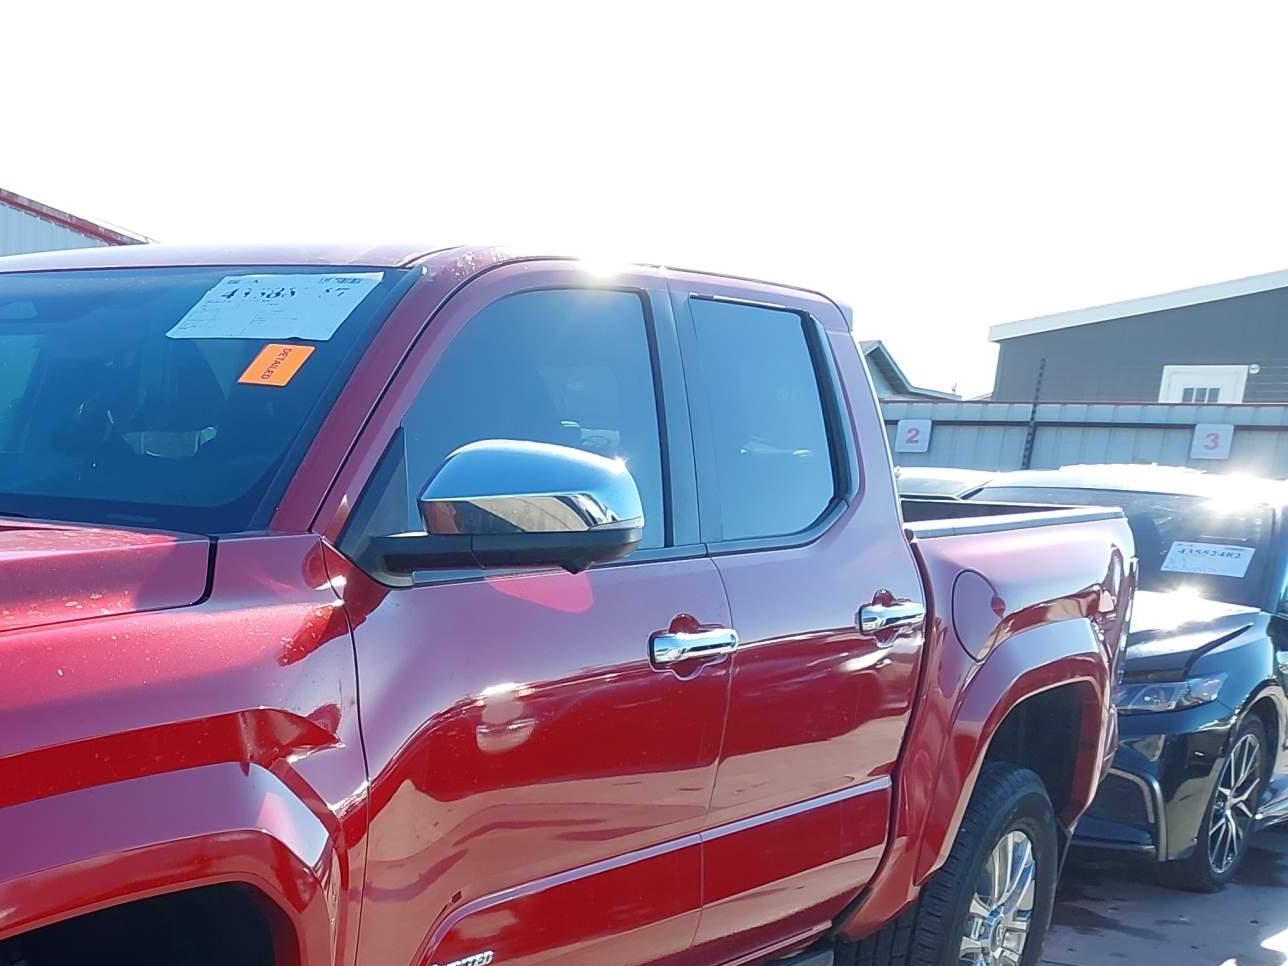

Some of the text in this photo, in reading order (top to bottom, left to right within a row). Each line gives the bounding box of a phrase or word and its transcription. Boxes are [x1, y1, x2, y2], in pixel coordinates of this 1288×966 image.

[261, 348, 292, 379] DETAILED
[905, 427, 920, 444] 2
[1203, 432, 1220, 450] 3
